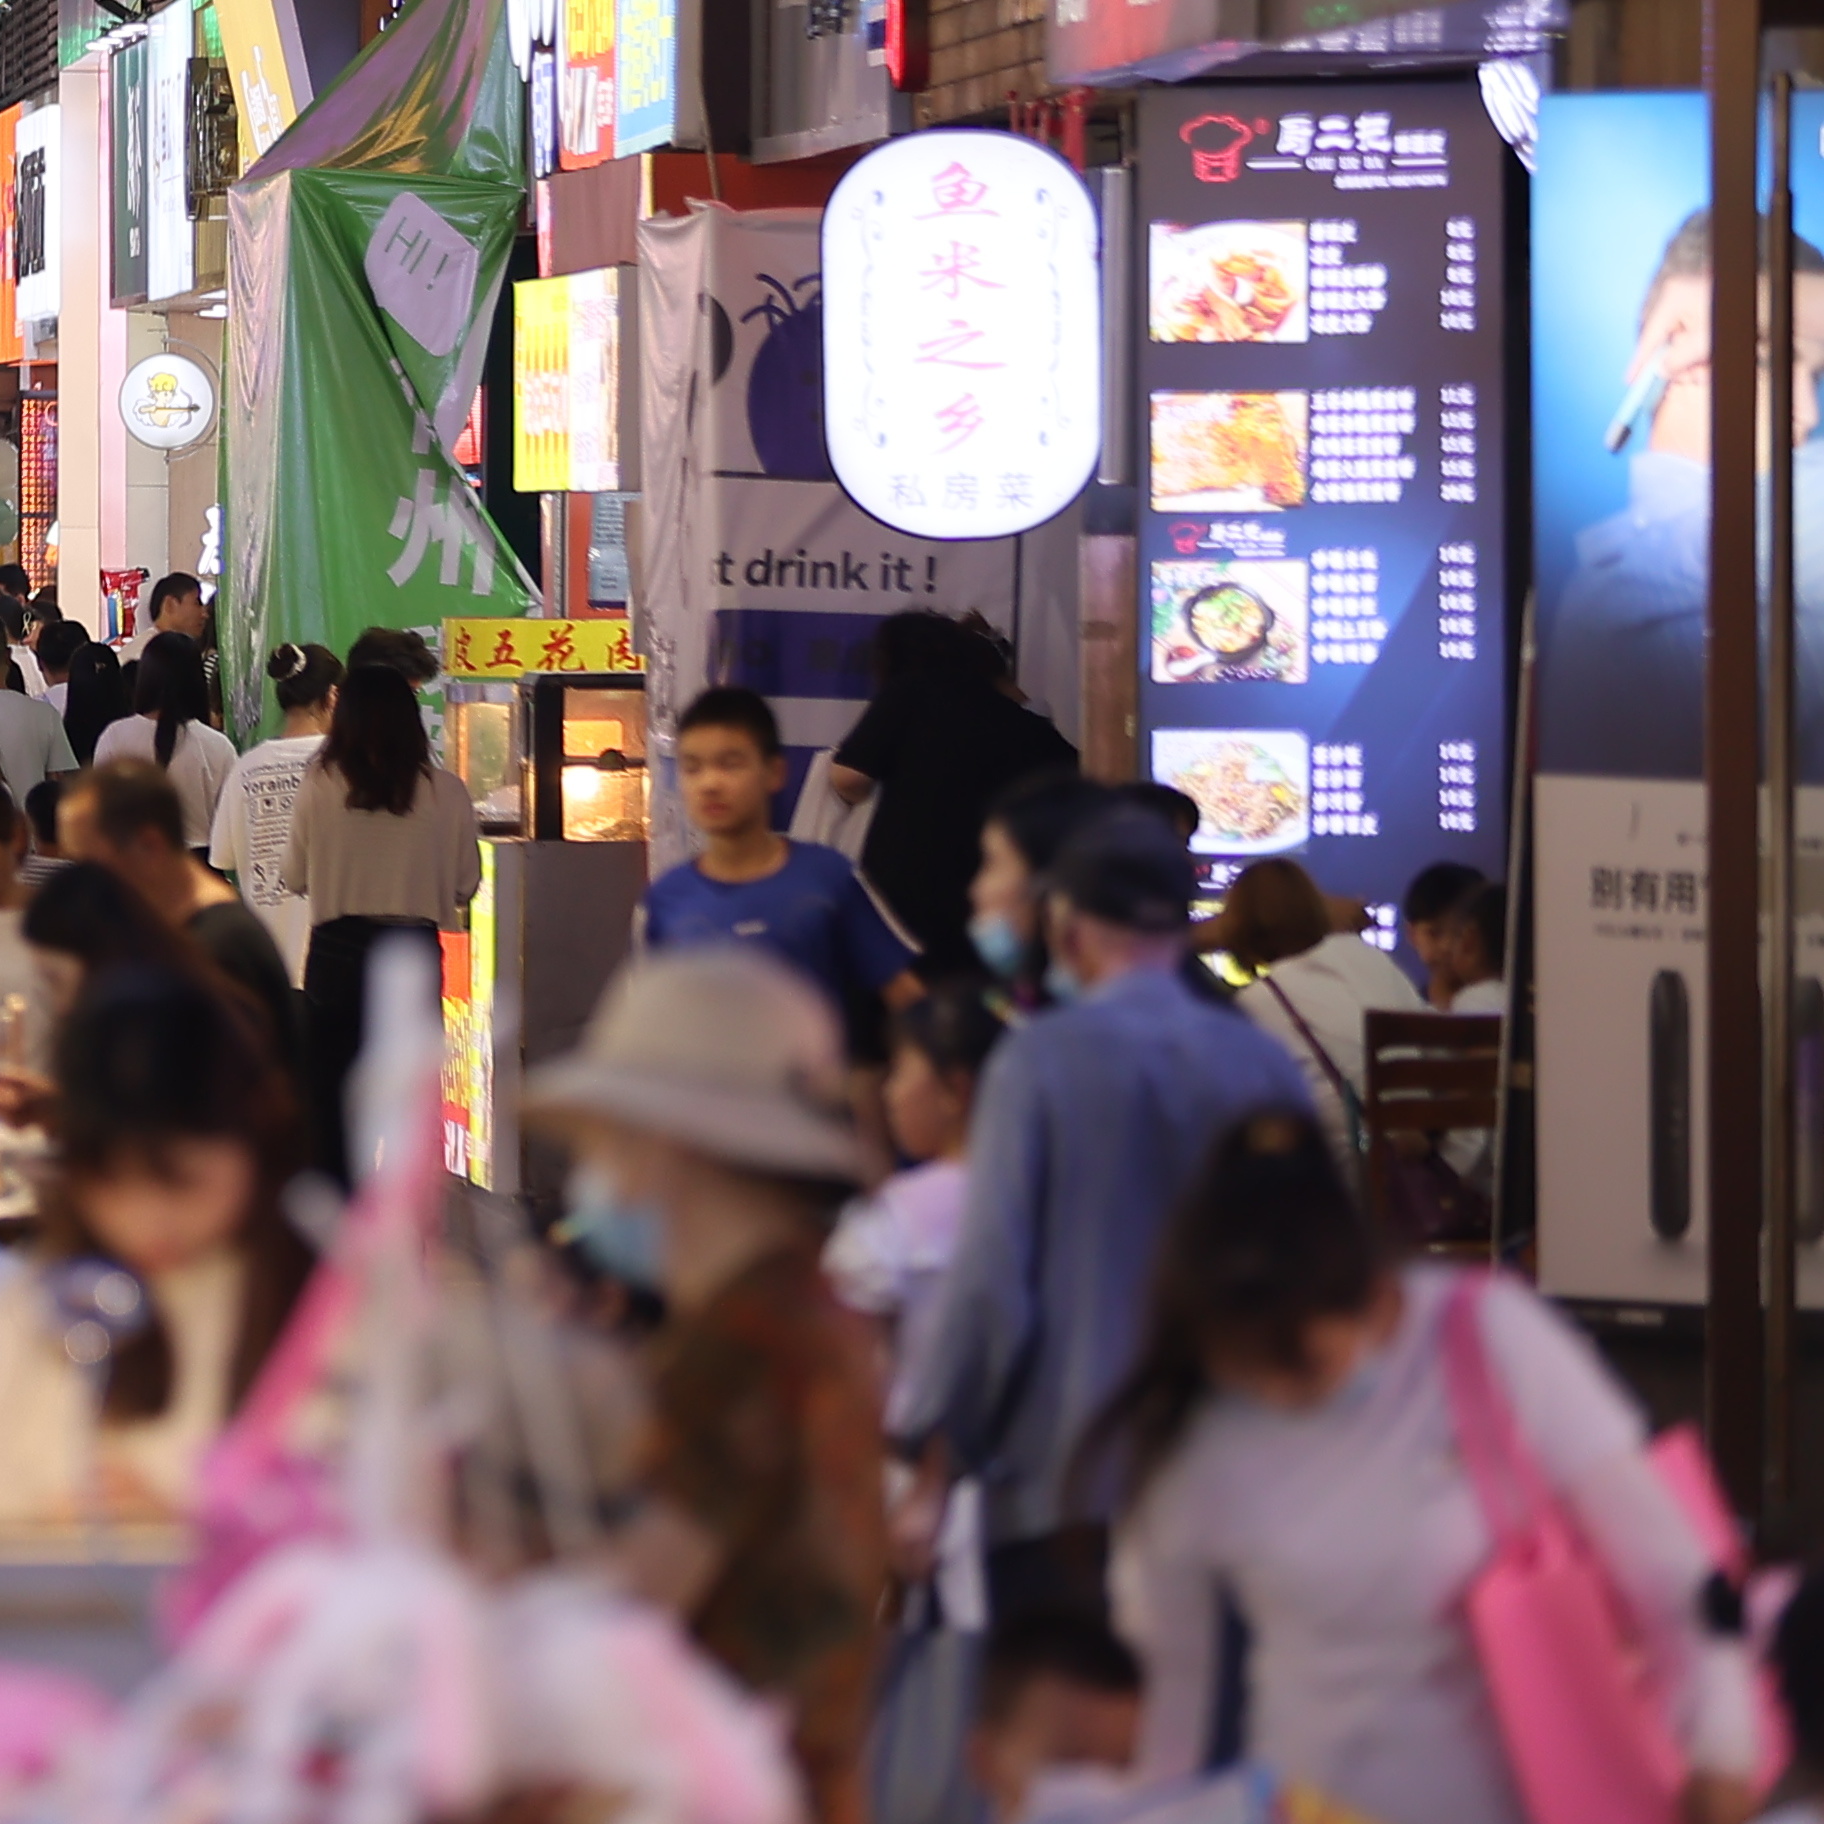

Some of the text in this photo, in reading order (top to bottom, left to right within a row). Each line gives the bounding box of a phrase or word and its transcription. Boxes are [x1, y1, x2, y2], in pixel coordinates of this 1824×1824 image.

[912, 161, 1008, 456] 鱼米之乡
[743, 546, 876, 589] drink
[1590, 867, 1708, 913] 别有用
